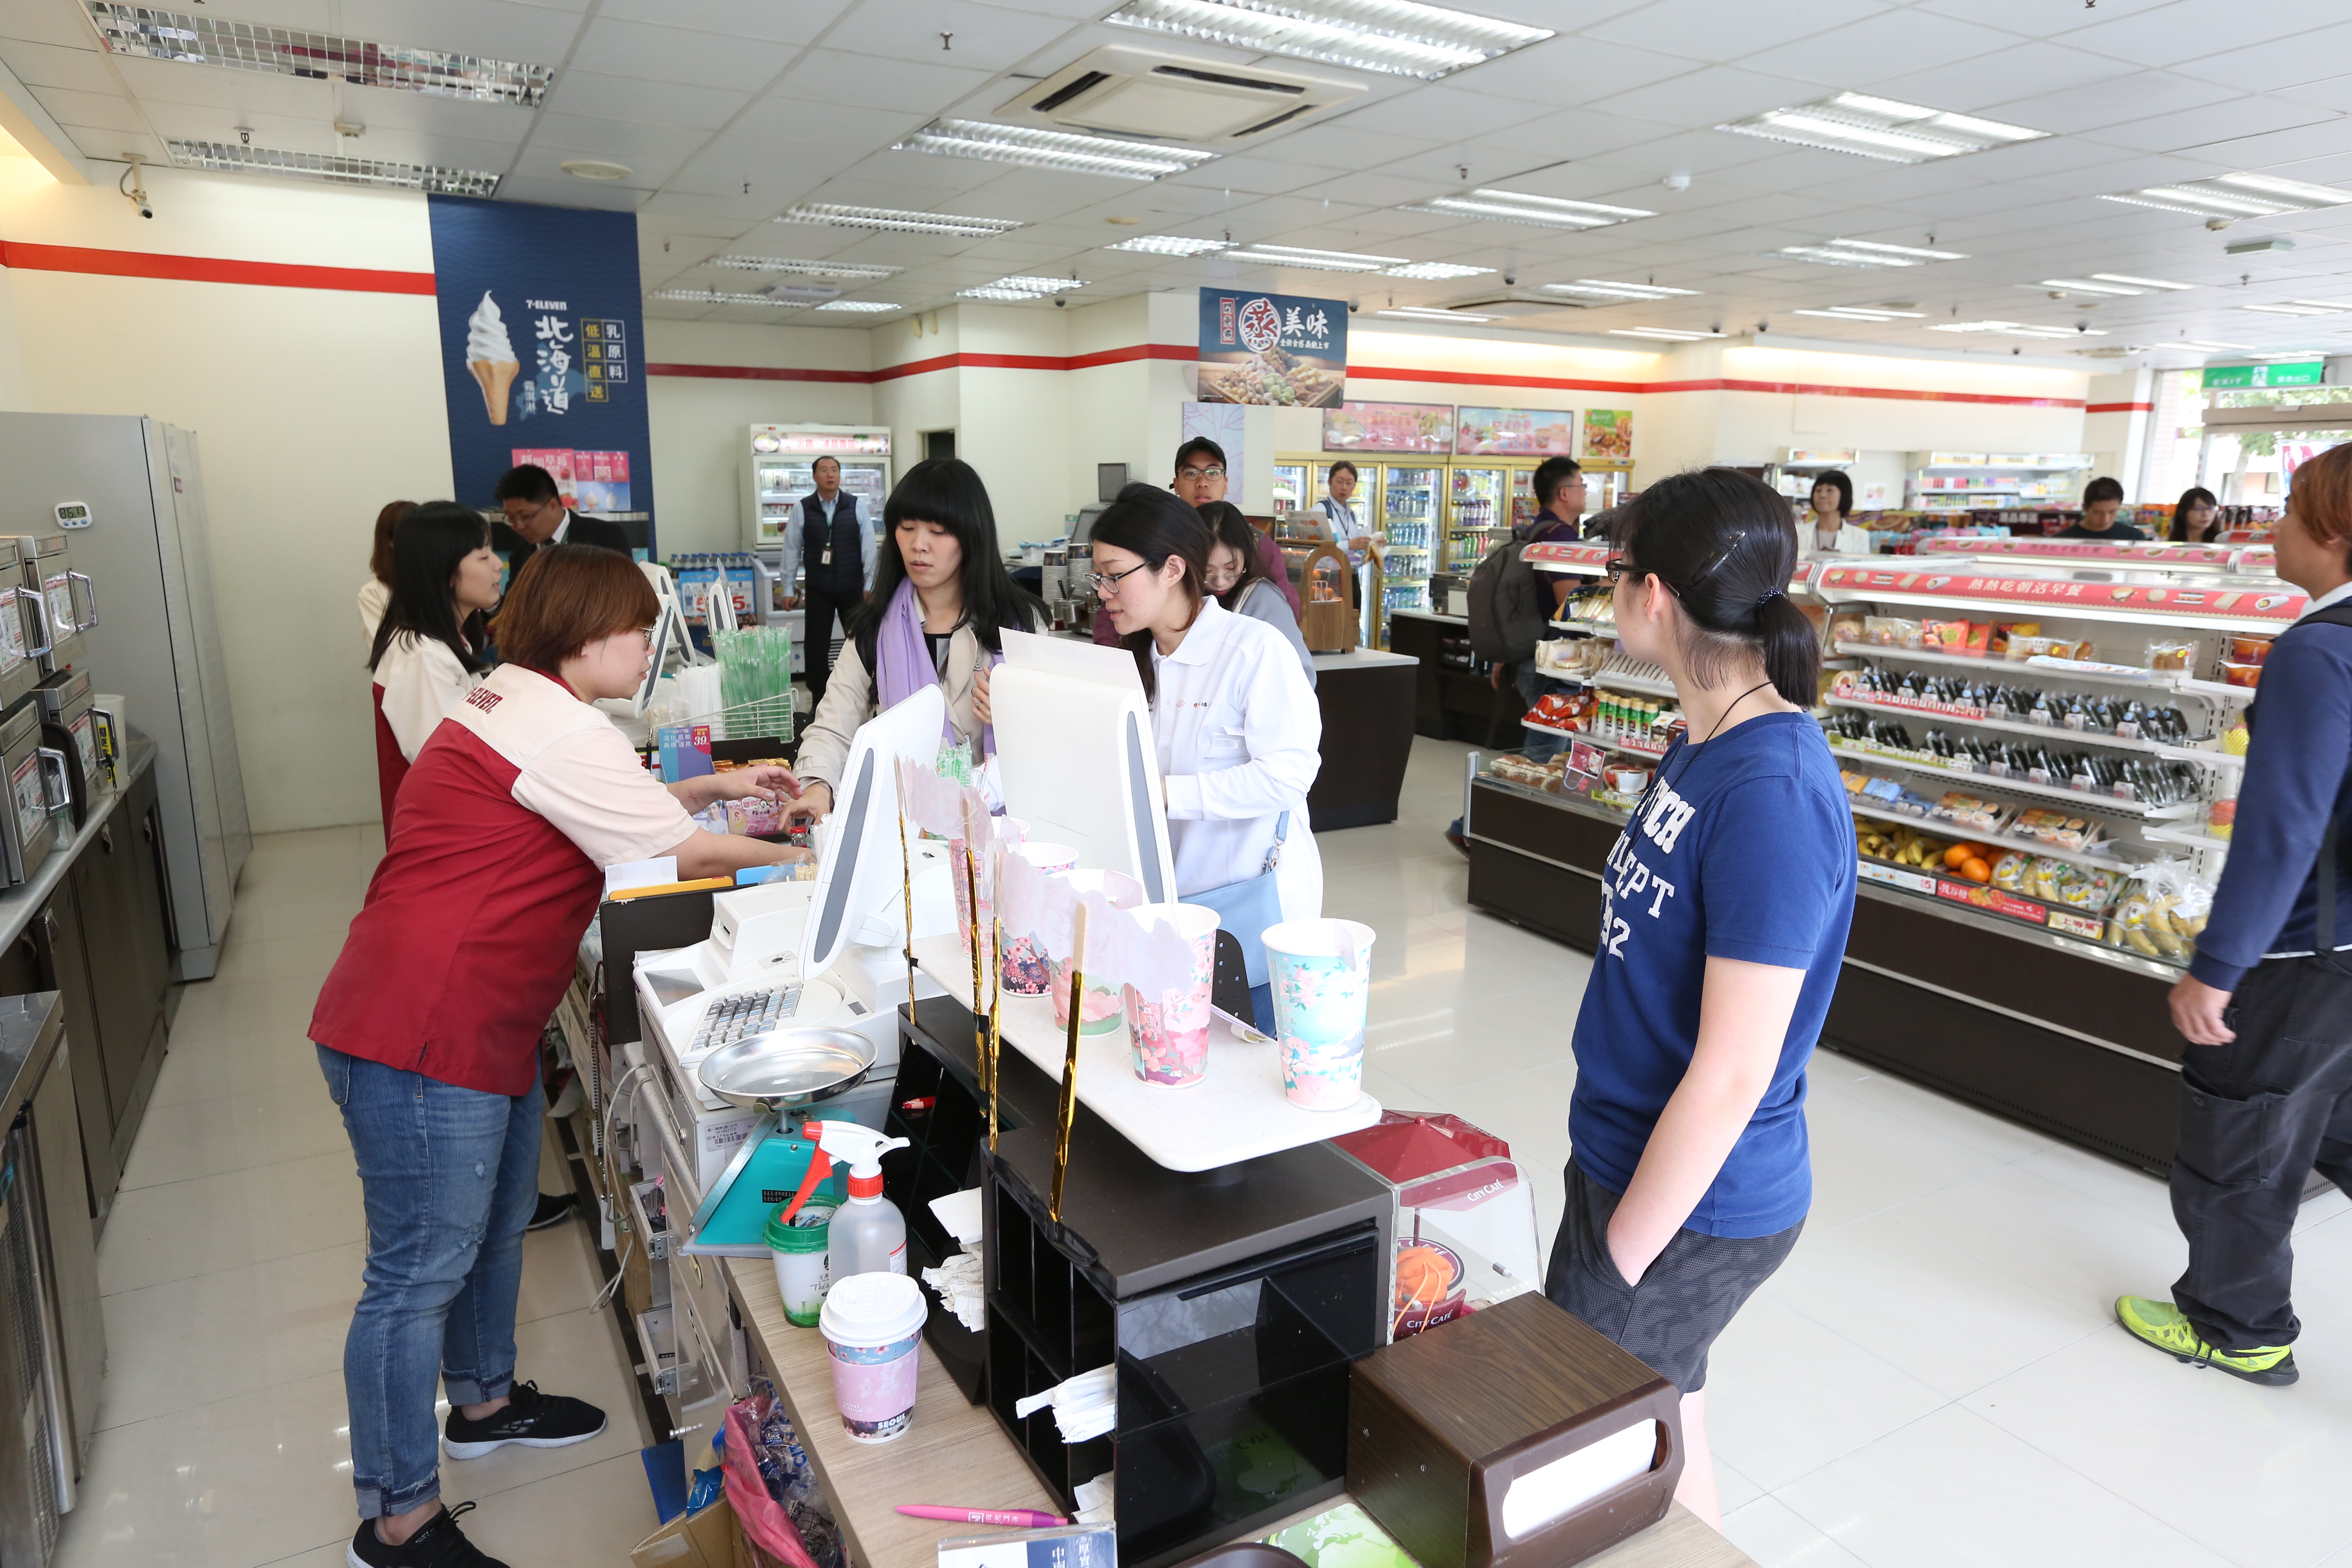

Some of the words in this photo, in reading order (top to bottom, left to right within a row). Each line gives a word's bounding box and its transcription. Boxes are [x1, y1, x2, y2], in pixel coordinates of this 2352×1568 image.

[1282, 306, 1329, 339] 美味
[606, 324, 623, 379] 乳原料
[535, 315, 574, 415] 北海道
[2212, 377, 2242, 386] EXIT
[694, 735, 707, 746] 39
[1467, 1189, 1486, 1202] CITY
[878, 1412, 906, 1430] SEOUL
[986, 1513, 1019, 1522] 世紀門市
